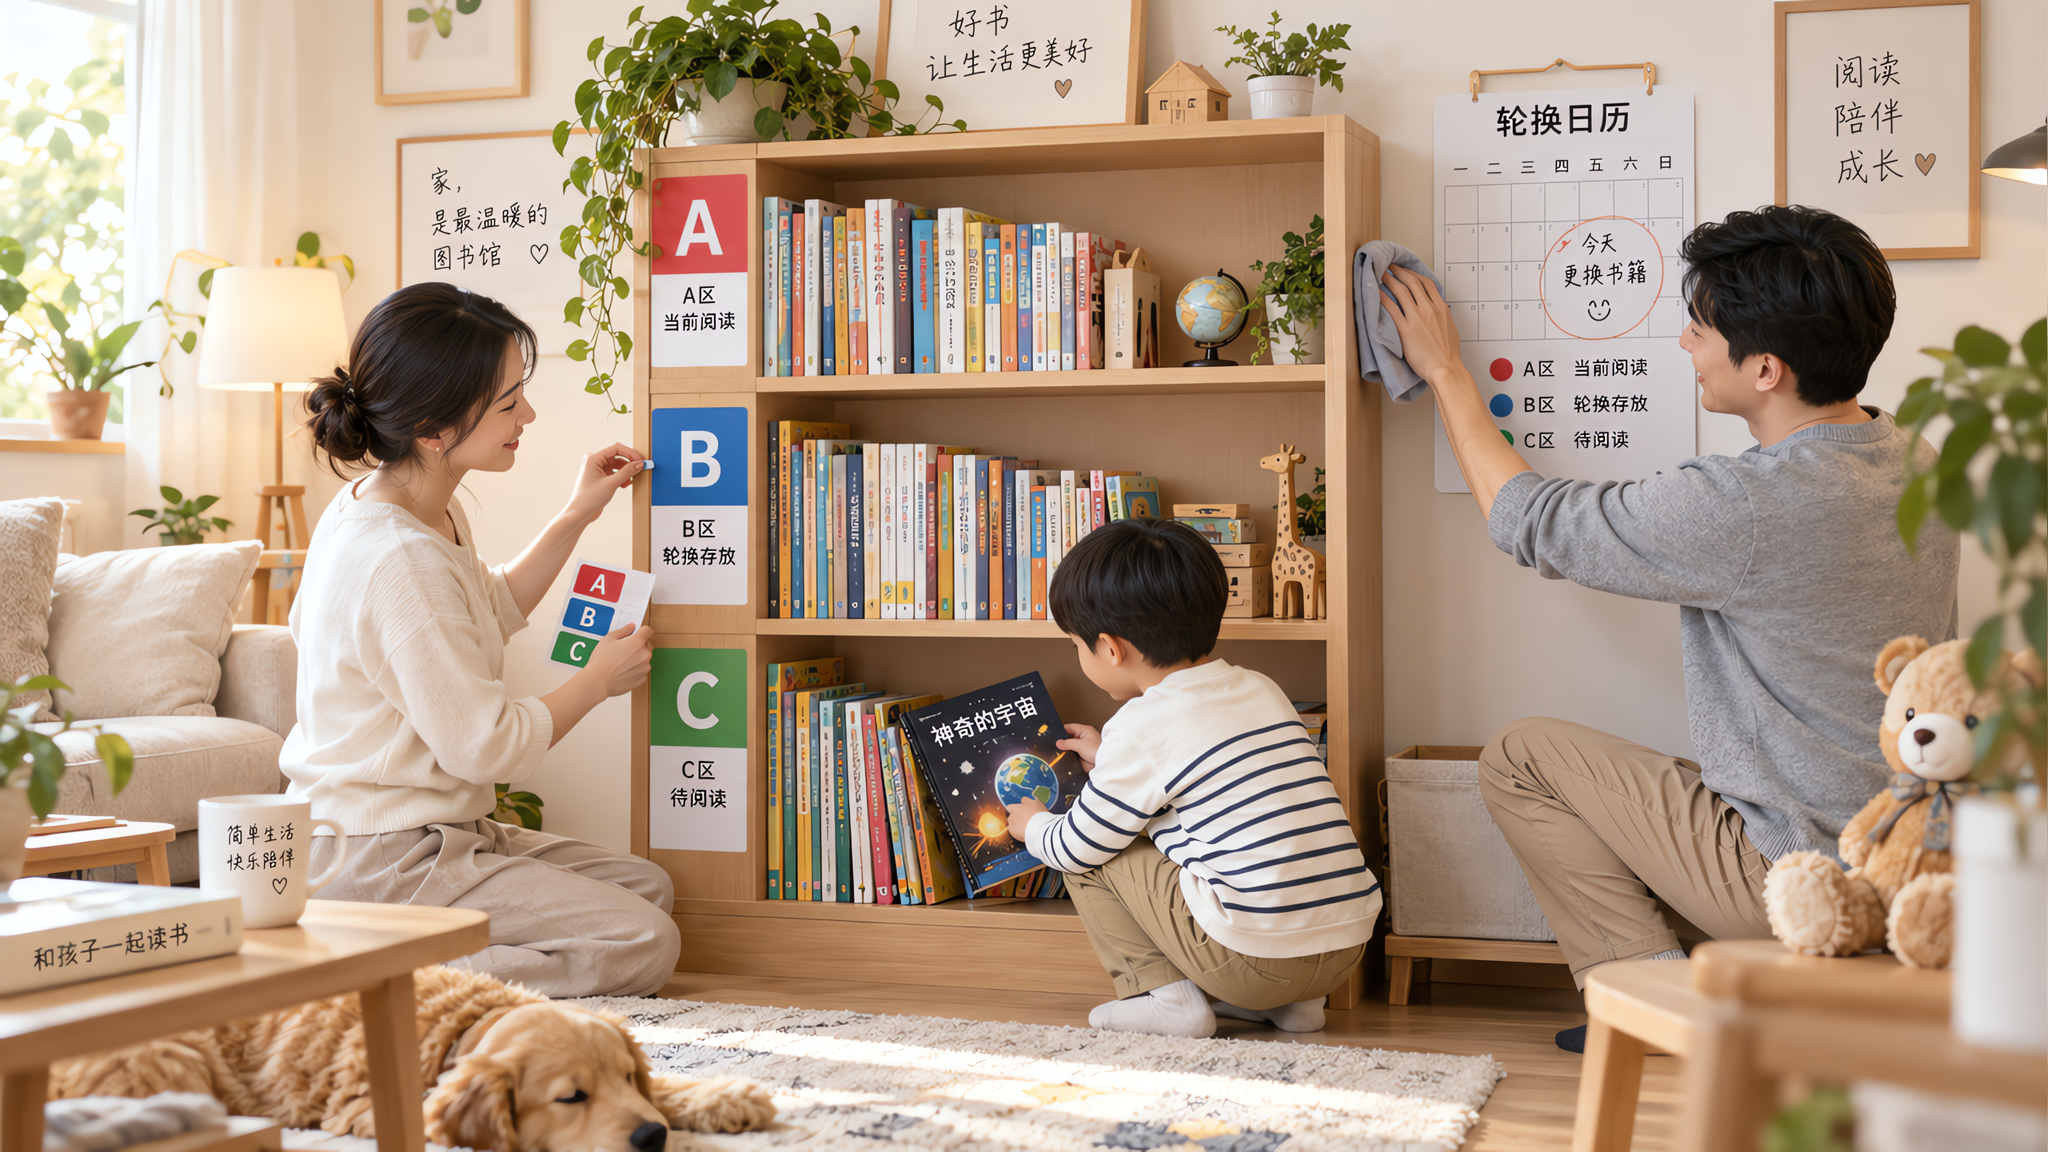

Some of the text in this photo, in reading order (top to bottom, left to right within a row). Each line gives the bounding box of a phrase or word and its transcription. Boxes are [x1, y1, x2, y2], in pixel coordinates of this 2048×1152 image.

[949, 4, 1009, 37] 好书
[926, 37, 1093, 81] 让生活更美好
[1835, 51, 1900, 88] 阅读
[1496, 102, 1630, 137] 轮换日历
[1835, 98, 1903, 137] 陪伴
[1486, 162, 1502, 174] 二
[1520, 160, 1536, 174] 三
[1554, 159, 1570, 173] 四
[1588, 157, 1604, 172] 五
[1623, 156, 1638, 171] 六
[1659, 155, 1672, 170] 日
[1838, 149, 1904, 184] 成长
[432, 202, 547, 236] 是最温暖的
[675, 199, 723, 257] A
[1581, 232, 1617, 255] 今天
[433, 242, 501, 270] 图书馆
[1564, 259, 1647, 288] 更换书籍
[683, 286, 716, 304] A区
[664, 312, 736, 331] 当前阅读
[1523, 358, 1648, 377] A区 当前阅读
[1524, 394, 1648, 413] B区 轮换存放
[1524, 430, 1629, 449] C区 待阅读
[680, 430, 722, 488] B
[683, 519, 716, 538] B区
[663, 546, 736, 565] 轮换存放
[589, 573, 606, 595] A
[579, 605, 597, 628] B
[569, 641, 587, 662] C
[676, 671, 720, 730] C
[930, 696, 1038, 748] 神奇的宇宙
[682, 760, 715, 780] C区
[670, 787, 727, 808] 待阅读
[227, 822, 294, 845] 简单生活
[227, 847, 295, 871] 快乐陪伴
[33, 922, 189, 971] 和孩子一起读书
